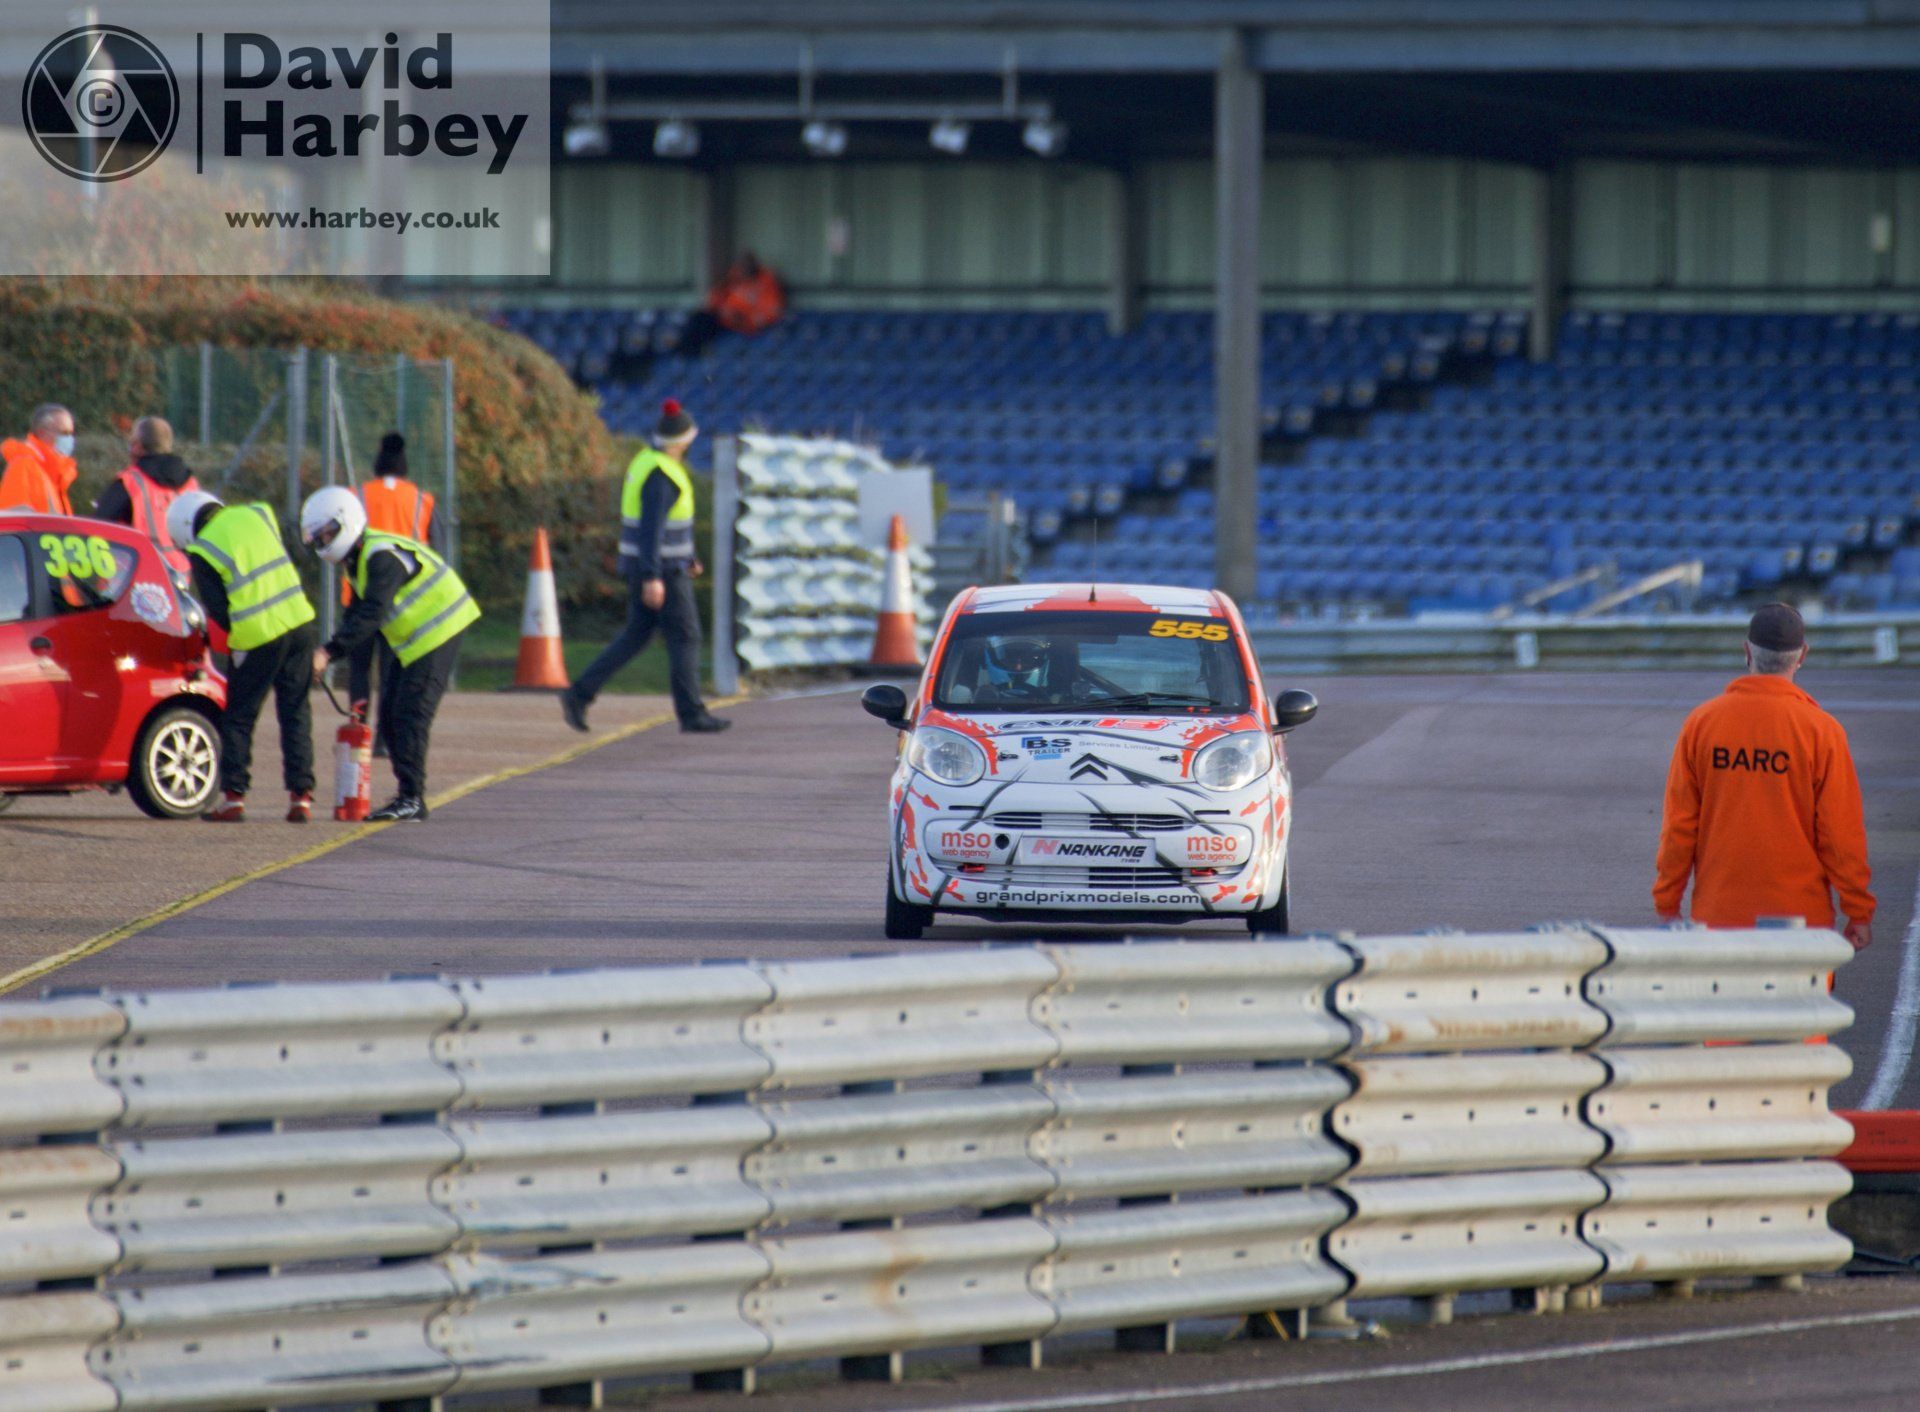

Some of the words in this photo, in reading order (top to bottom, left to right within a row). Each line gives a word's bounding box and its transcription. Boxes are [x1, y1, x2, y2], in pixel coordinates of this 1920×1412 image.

[39, 534, 117, 579] 336
[1148, 619, 1229, 641] 555
[1026, 738, 1072, 749] BS
[1078, 740, 1121, 749] Services
[1124, 743, 1160, 752] Limited
[1028, 748, 1071, 756] TRAILER
[1712, 747, 1790, 774] BARC
[941, 832, 991, 848] mso
[1187, 836, 1237, 852] mso
[960, 850, 990, 858] agency
[1057, 844, 1147, 858] NANKANG
[1188, 853, 1205, 861] web
[1207, 853, 1237, 862] agency
[976, 891, 1199, 904] grandprixmodels.com
